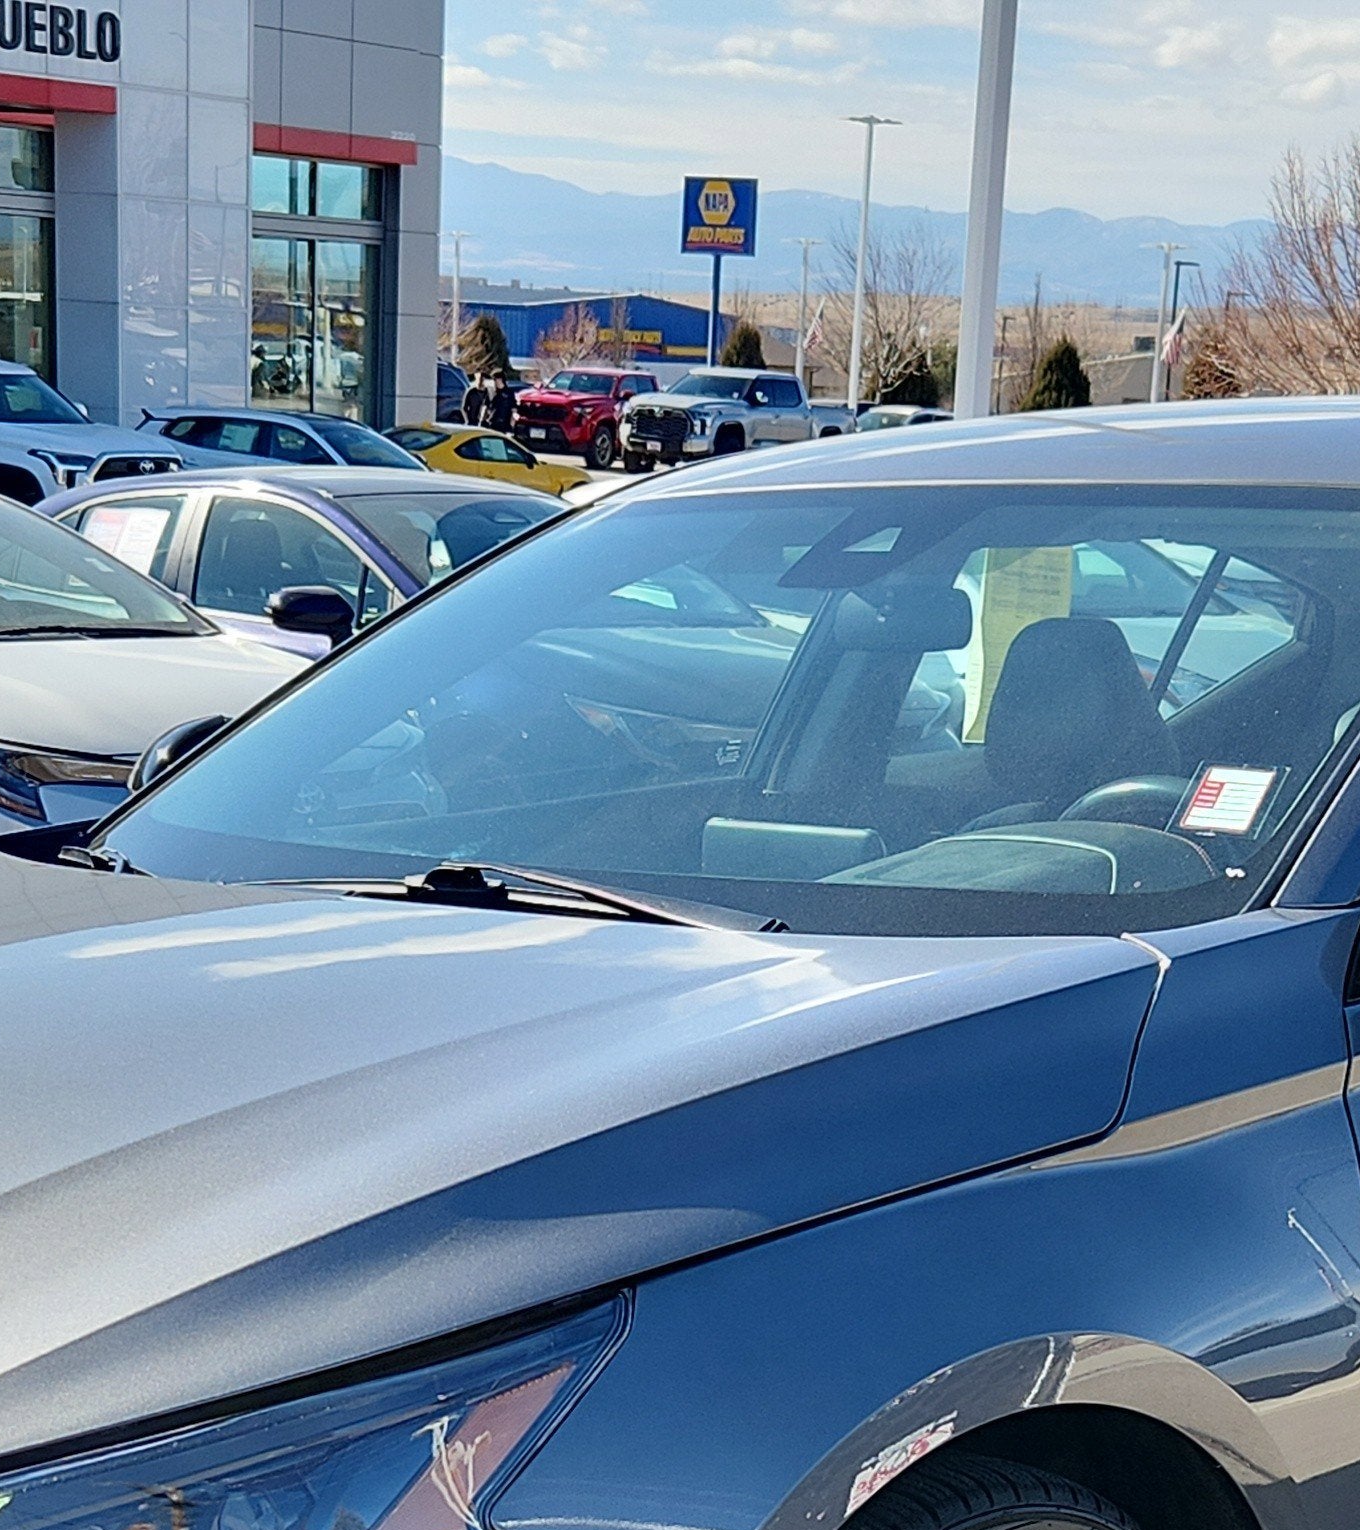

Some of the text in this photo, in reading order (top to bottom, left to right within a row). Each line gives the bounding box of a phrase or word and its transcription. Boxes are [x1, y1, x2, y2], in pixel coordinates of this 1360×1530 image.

[705, 192, 729, 211] NAPA
[686, 226, 746, 245] AUTO PARTS
